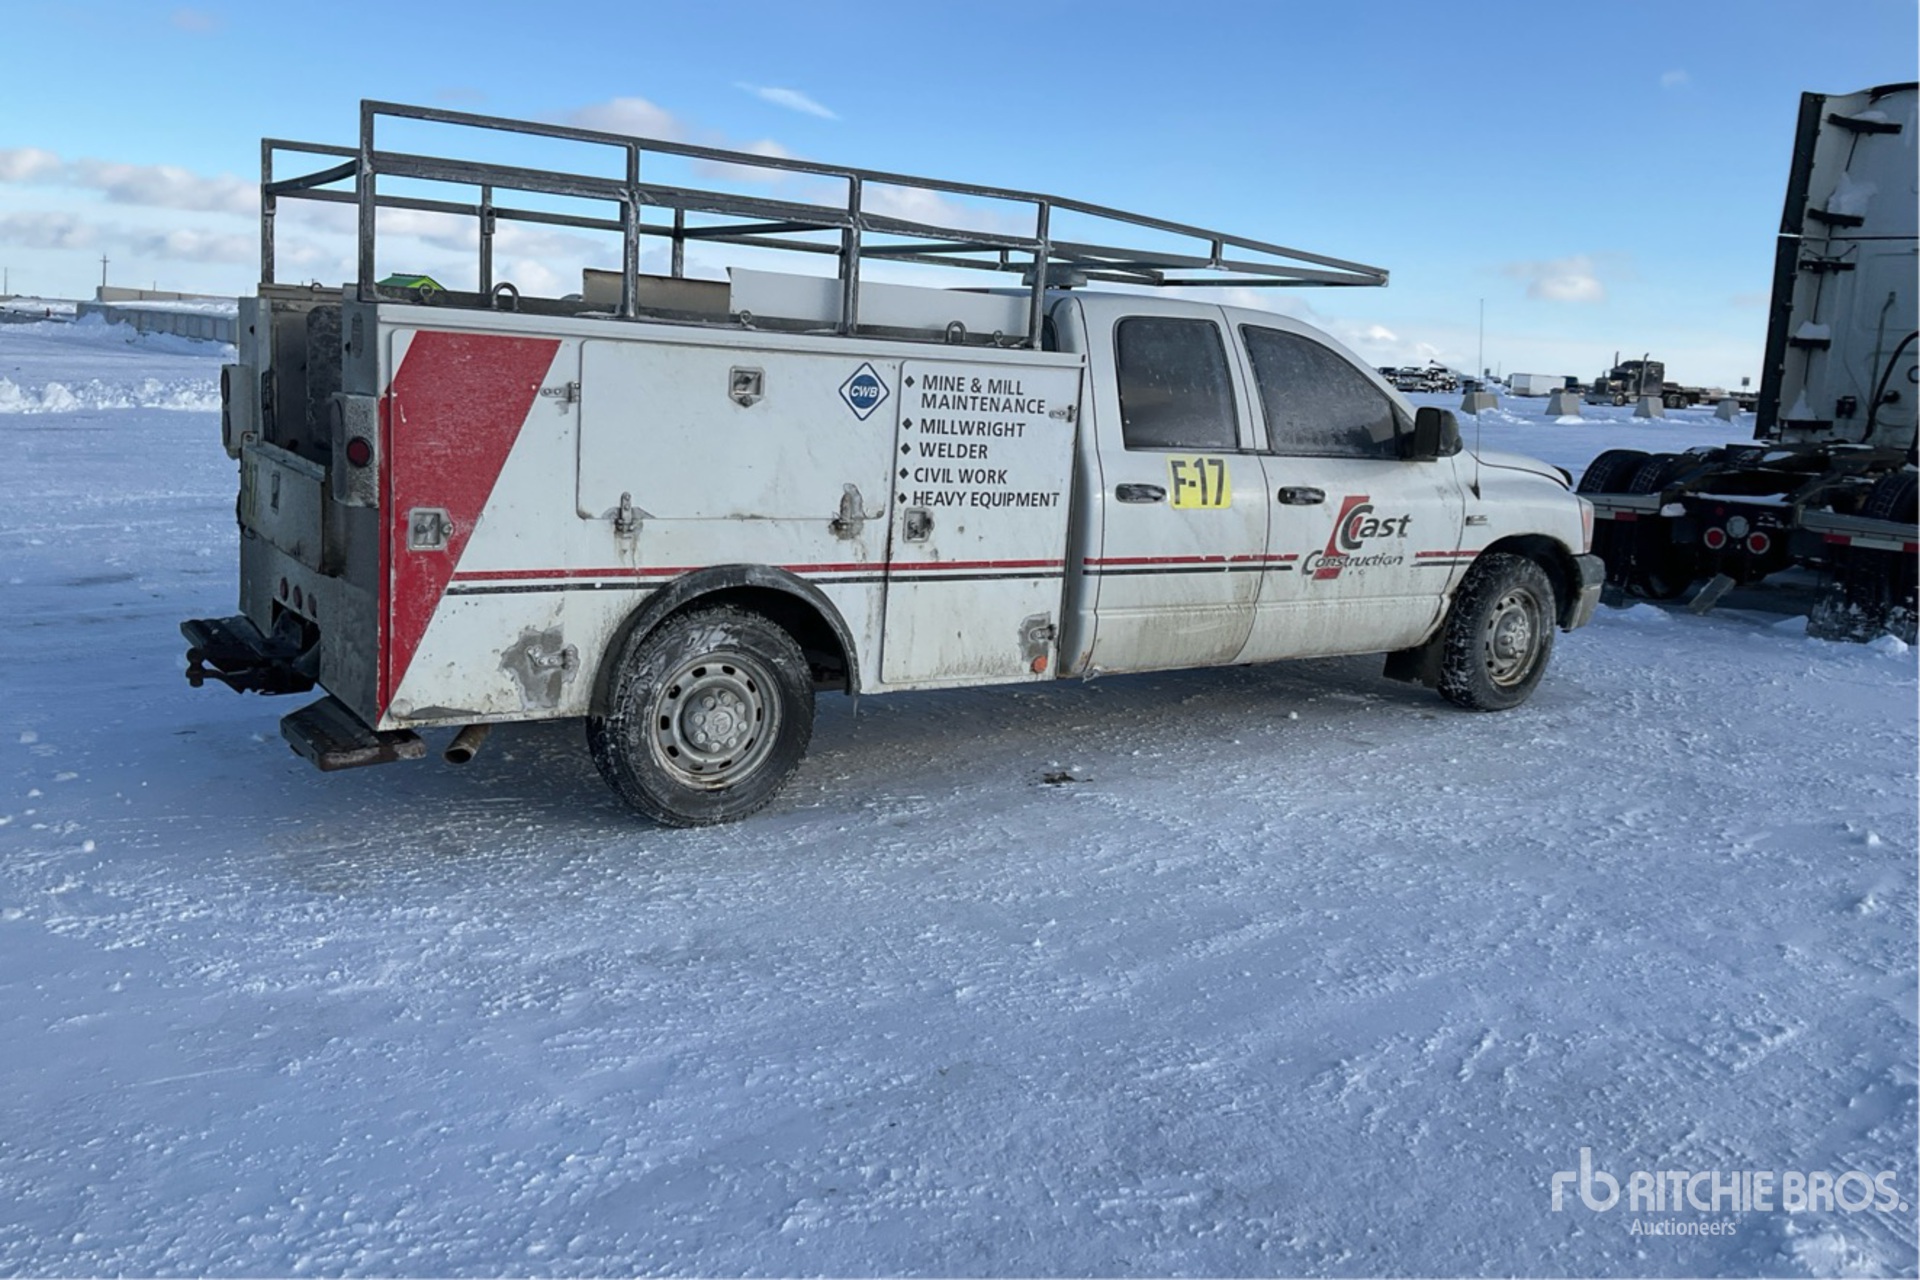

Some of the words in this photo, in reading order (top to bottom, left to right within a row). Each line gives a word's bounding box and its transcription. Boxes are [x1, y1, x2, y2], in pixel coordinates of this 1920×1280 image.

[851, 385, 878, 398] CWB
[922, 374, 966, 393] MINE
[970, 377, 982, 394] &
[987, 378, 1024, 396] MILL
[921, 392, 1046, 415] MAINTENANCE
[920, 418, 1026, 438] MILLWRIGHT
[919, 441, 988, 460] WELDER
[914, 467, 954, 484] CIVIL
[958, 468, 1008, 485] WORK
[1170, 457, 1225, 506] F-17
[912, 490, 967, 507] HEAVY
[970, 491, 1060, 509] EQUIPMENT
[1301, 549, 1404, 575] Construction
